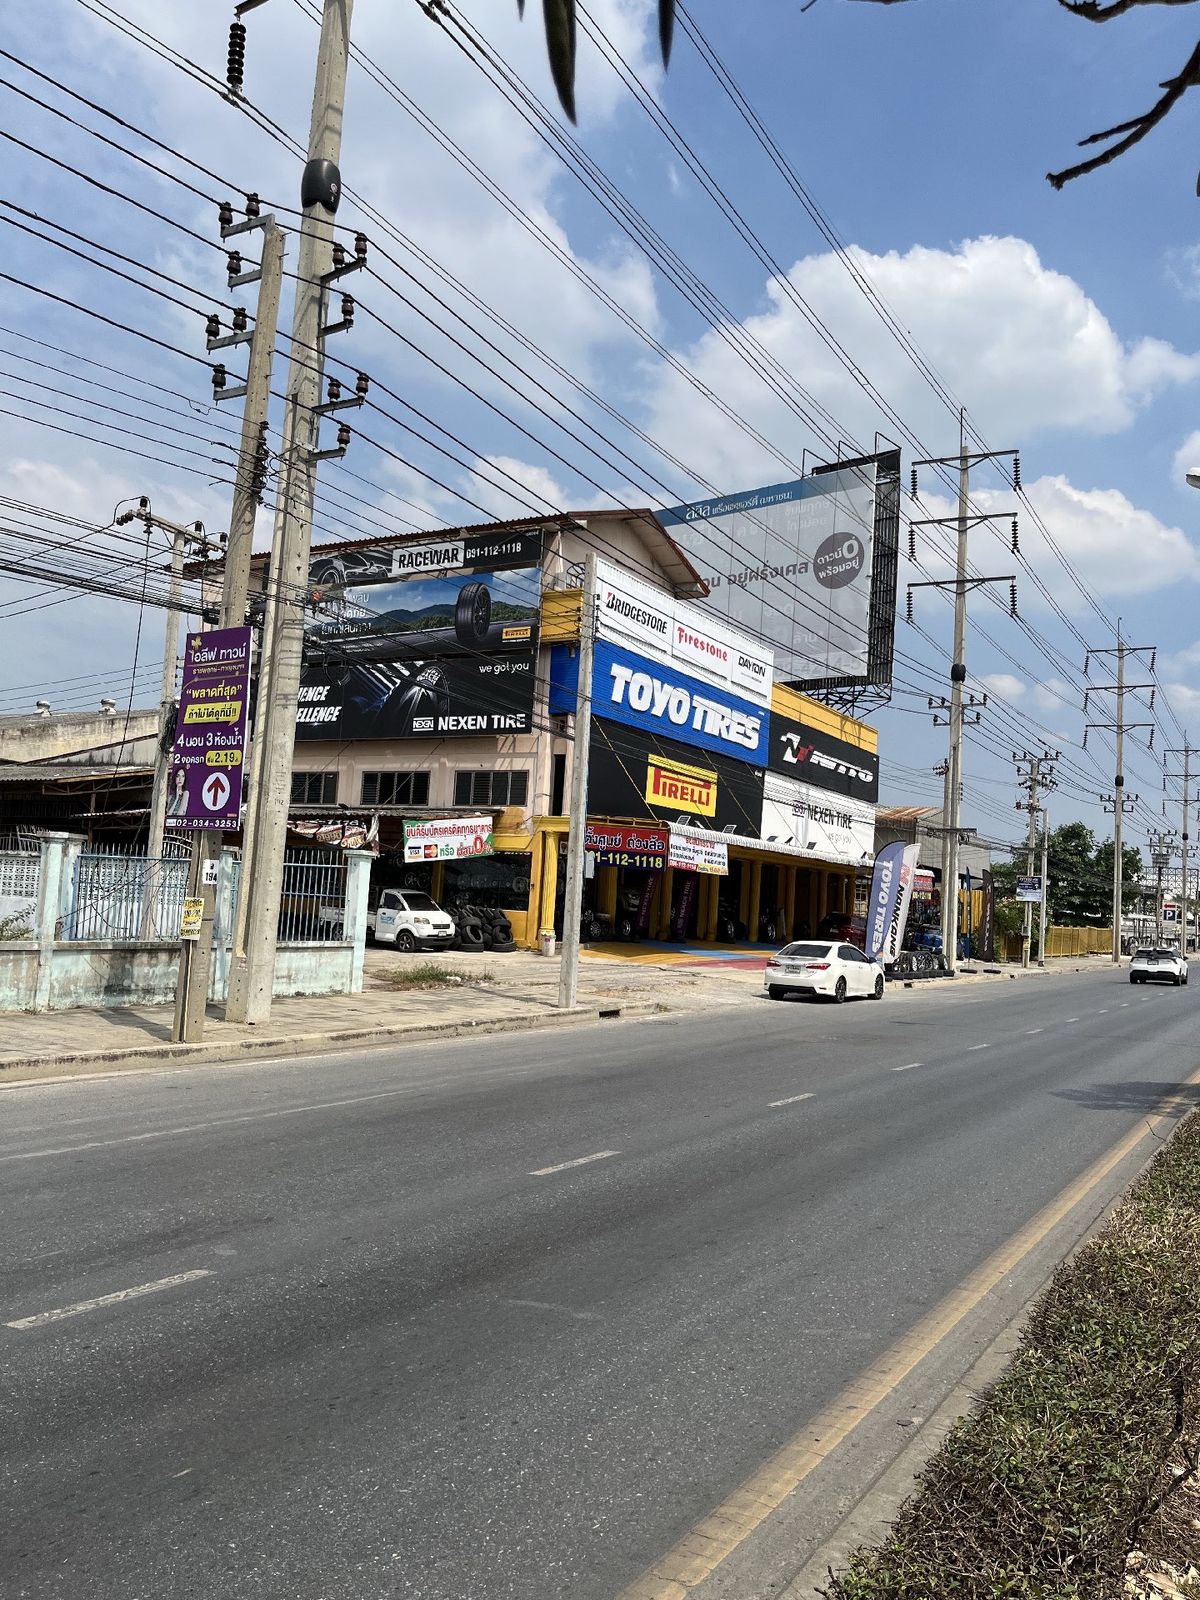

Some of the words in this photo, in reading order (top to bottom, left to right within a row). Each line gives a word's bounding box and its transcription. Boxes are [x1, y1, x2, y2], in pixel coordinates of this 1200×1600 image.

[398, 547, 460, 569] RACEWAR
[818, 556, 860, 579] พร้อมอยู่
[606, 591, 667, 635] BRIDGESTONE
[677, 625, 728, 662] Firestone
[479, 665, 492, 673] we
[511, 662, 530, 674] you
[610, 663, 691, 726] TOYO
[692, 695, 761, 750] TIRES
[437, 714, 487, 731] NEXEN
[491, 713, 526, 729] TIRE
[177, 733, 185, 747] 4
[185, 736, 204, 747] นอน
[206, 732, 214, 747] 3
[214, 728, 243, 746] ห้องน้ำ
[174, 753, 181, 764] 2
[215, 752, 235, 763] 2.19
[652, 765, 710, 807] PIRELLI
[176, 818, 237, 828] 02-034-3253
[807, 803, 834, 826] NEXEN
[836, 811, 852, 830] TIRE
[626, 833, 666, 851] ถ่วงล้อ
[205, 872, 218, 882] 194
[878, 860, 893, 905] TOYO
[889, 885, 905, 957] NANKANG
[1166, 910, 1173, 920] P
[871, 906, 887, 953] TIRES
